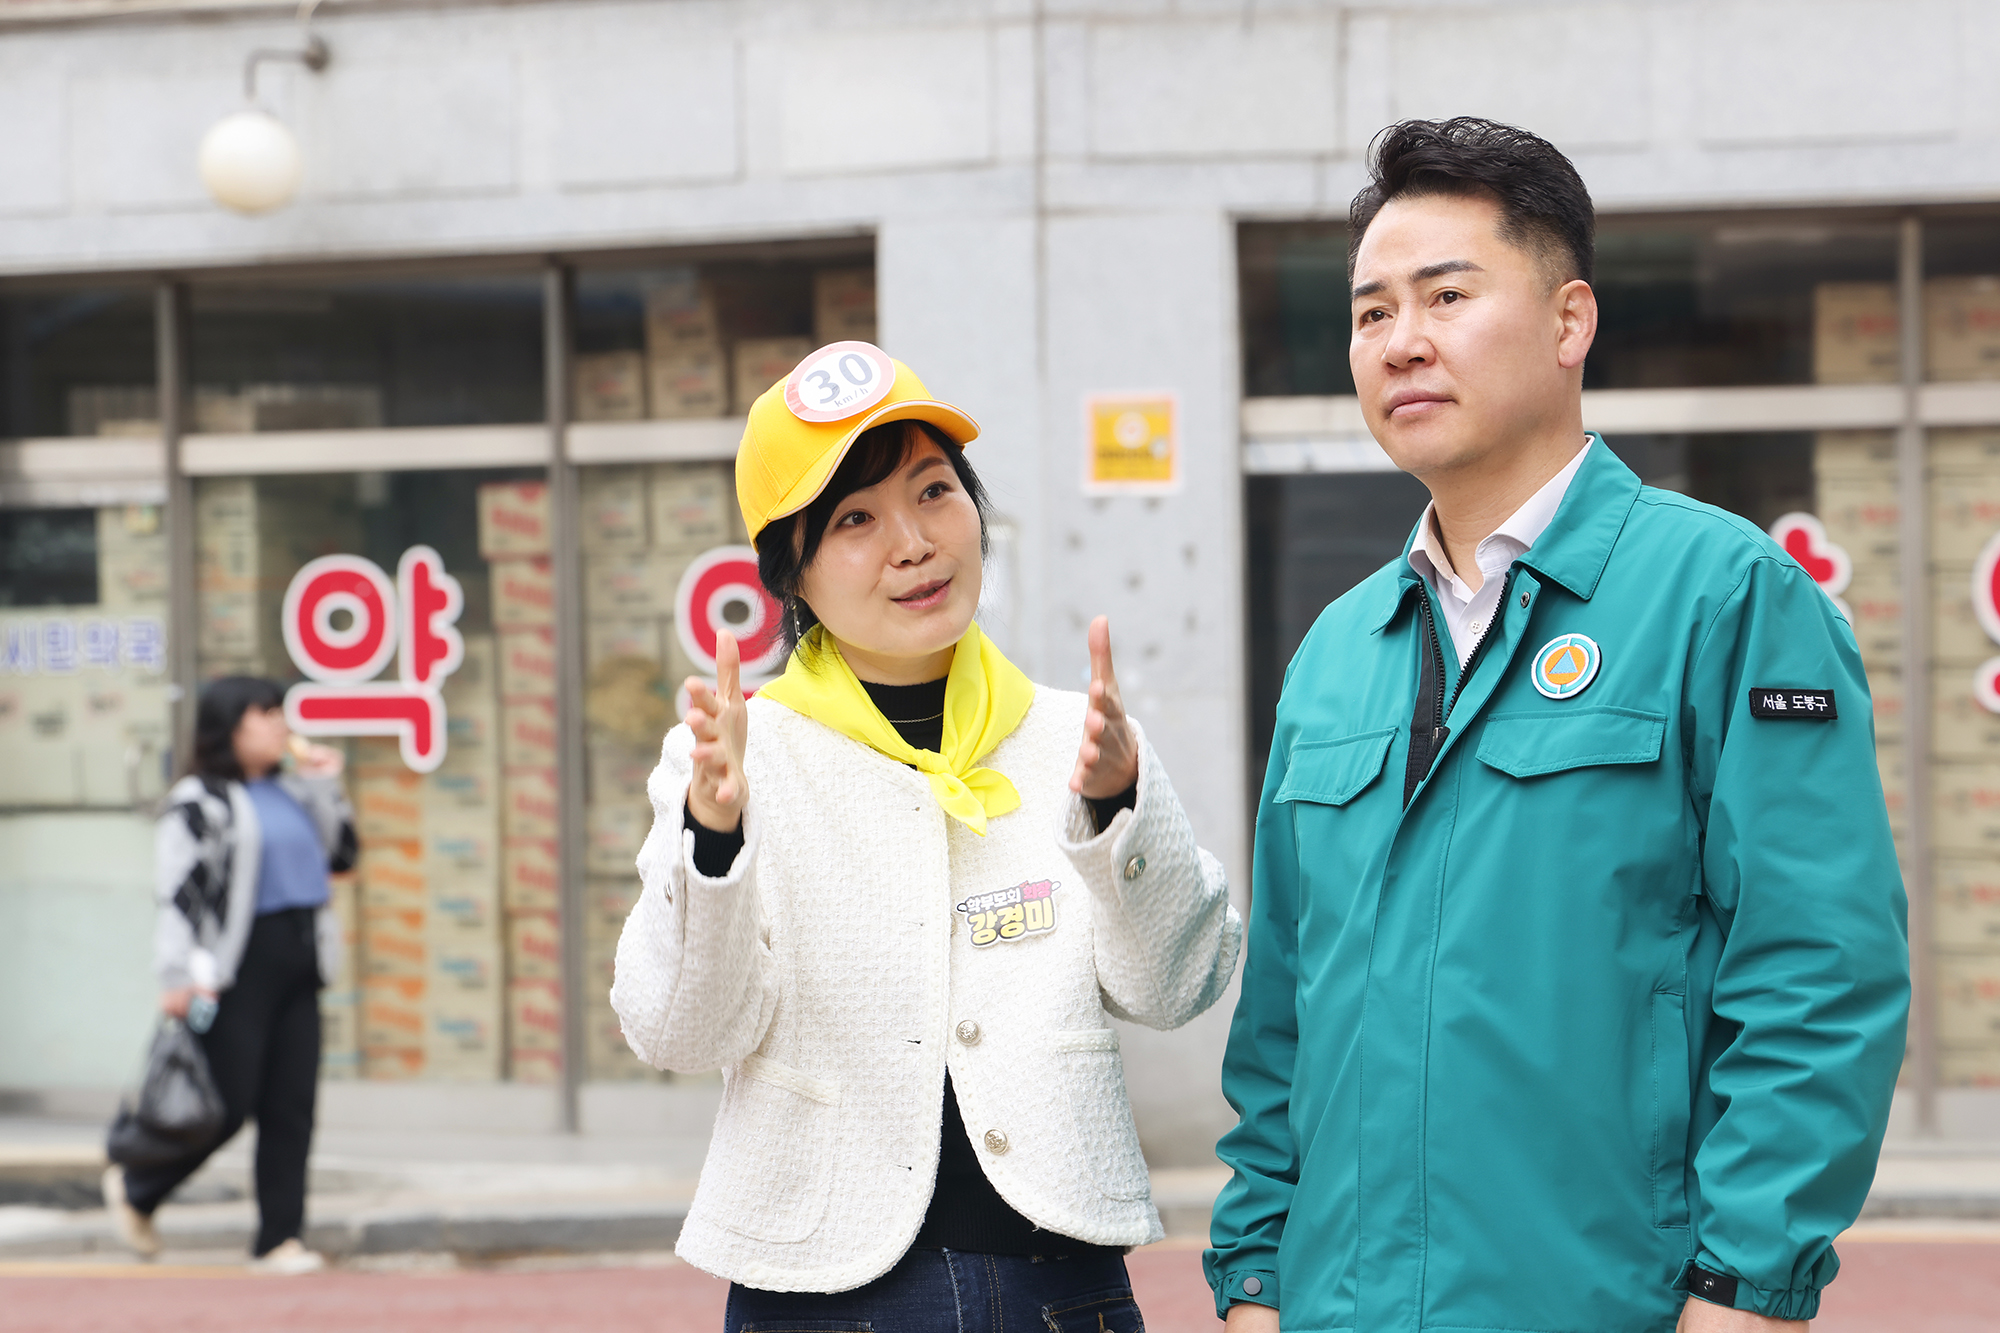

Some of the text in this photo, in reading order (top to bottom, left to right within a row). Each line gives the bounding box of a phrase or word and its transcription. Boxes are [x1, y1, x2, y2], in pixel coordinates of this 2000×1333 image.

[804, 353, 873, 405] 30
[834, 387, 869, 408] km/h
[286, 549, 457, 769] 약
[1762, 693, 1829, 712] 서울 도봉구
[965, 887, 1021, 913] 학부모회
[968, 896, 1054, 945] 강경미
